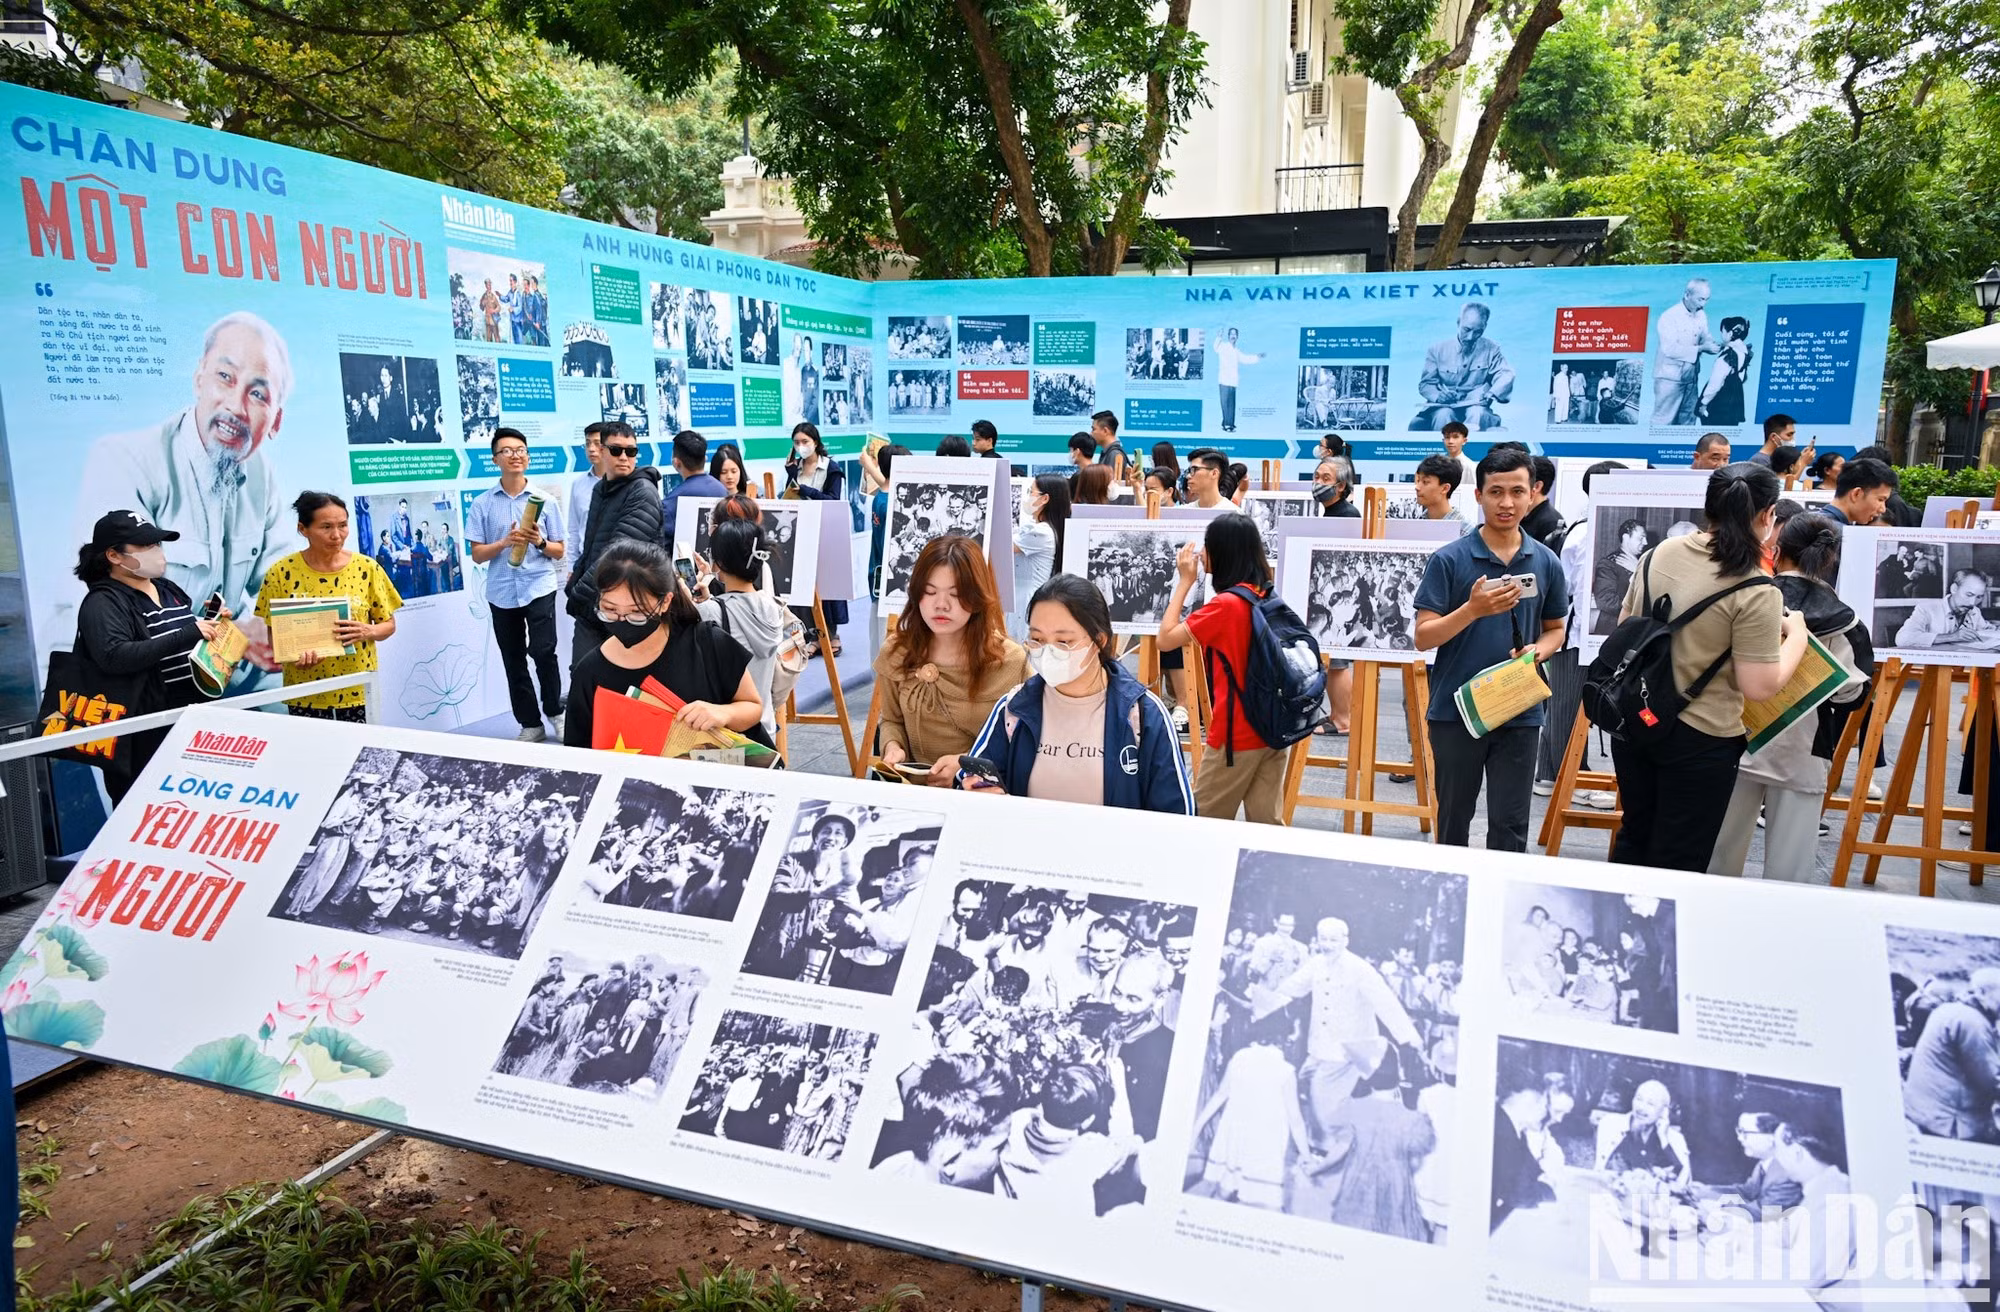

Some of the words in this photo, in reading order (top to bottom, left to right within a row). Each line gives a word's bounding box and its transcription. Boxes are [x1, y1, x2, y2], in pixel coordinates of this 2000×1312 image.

[173, 147, 287, 197] DUNG
[20, 173, 148, 272] MỘT
[176, 201, 280, 281] CON
[299, 220, 427, 299] NGƯỜI
[442, 194, 485, 229] Nhân
[484, 204, 515, 234] Dân
[582, 232, 620, 255] ANH
[59, 689, 127, 726] VIỆT
[188, 730, 235, 752] Nhân
[231, 736, 268, 756] Dân
[129, 800, 199, 849] YÊU
[189, 809, 280, 864] KÍNH
[76, 860, 246, 942] NGƯỜI
